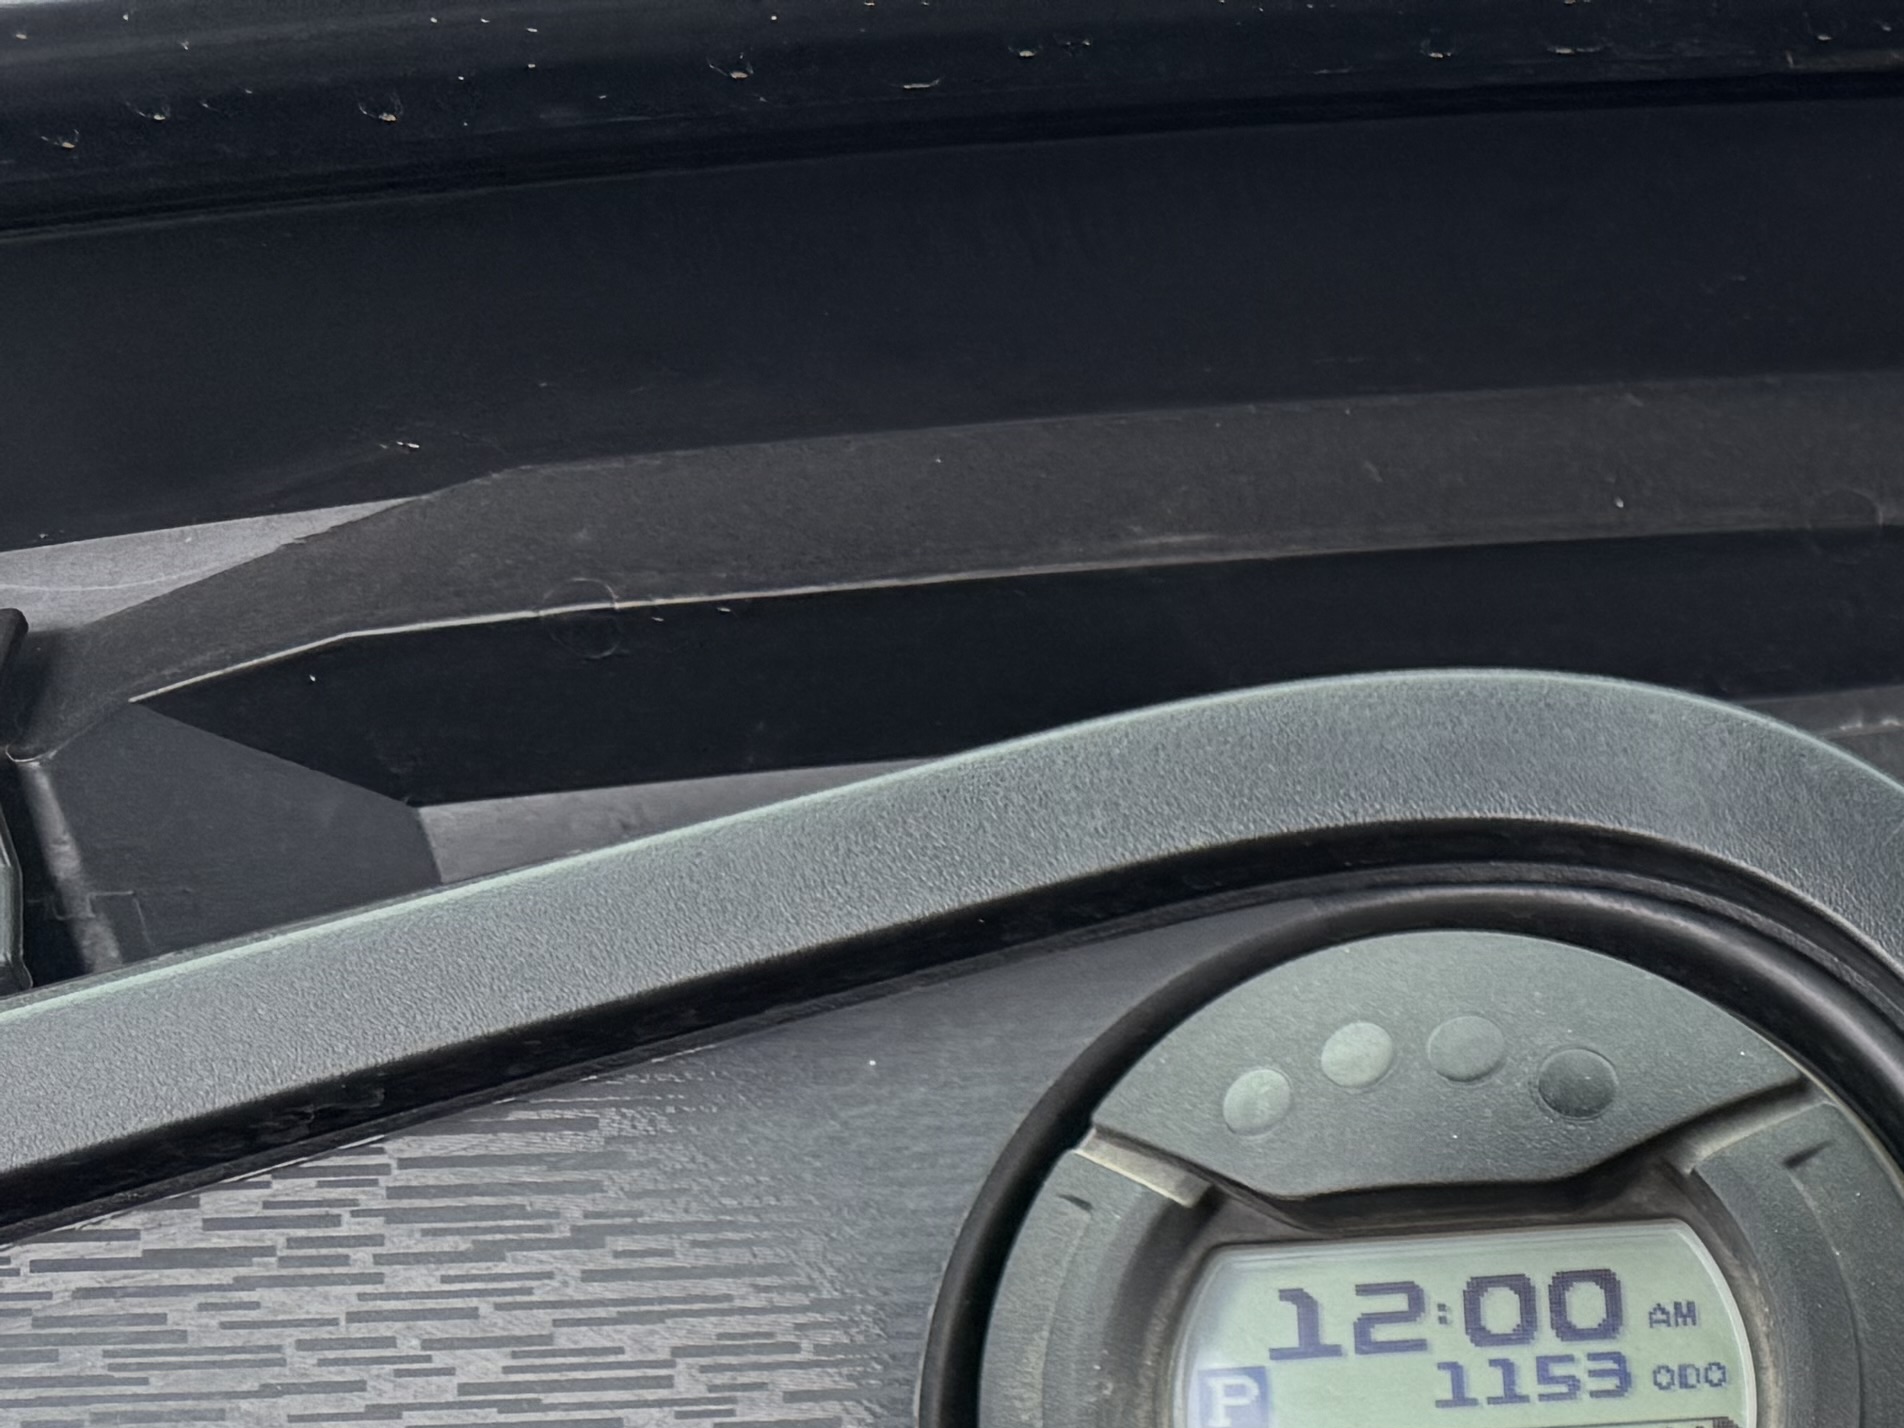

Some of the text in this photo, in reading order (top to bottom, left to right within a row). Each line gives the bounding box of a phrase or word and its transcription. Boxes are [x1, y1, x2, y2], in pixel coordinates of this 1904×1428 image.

[1268, 1269, 1697, 1360] 12:00 AM
[1205, 1375, 1260, 1428] P
[1434, 1351, 1727, 1409] 1153 ODO
